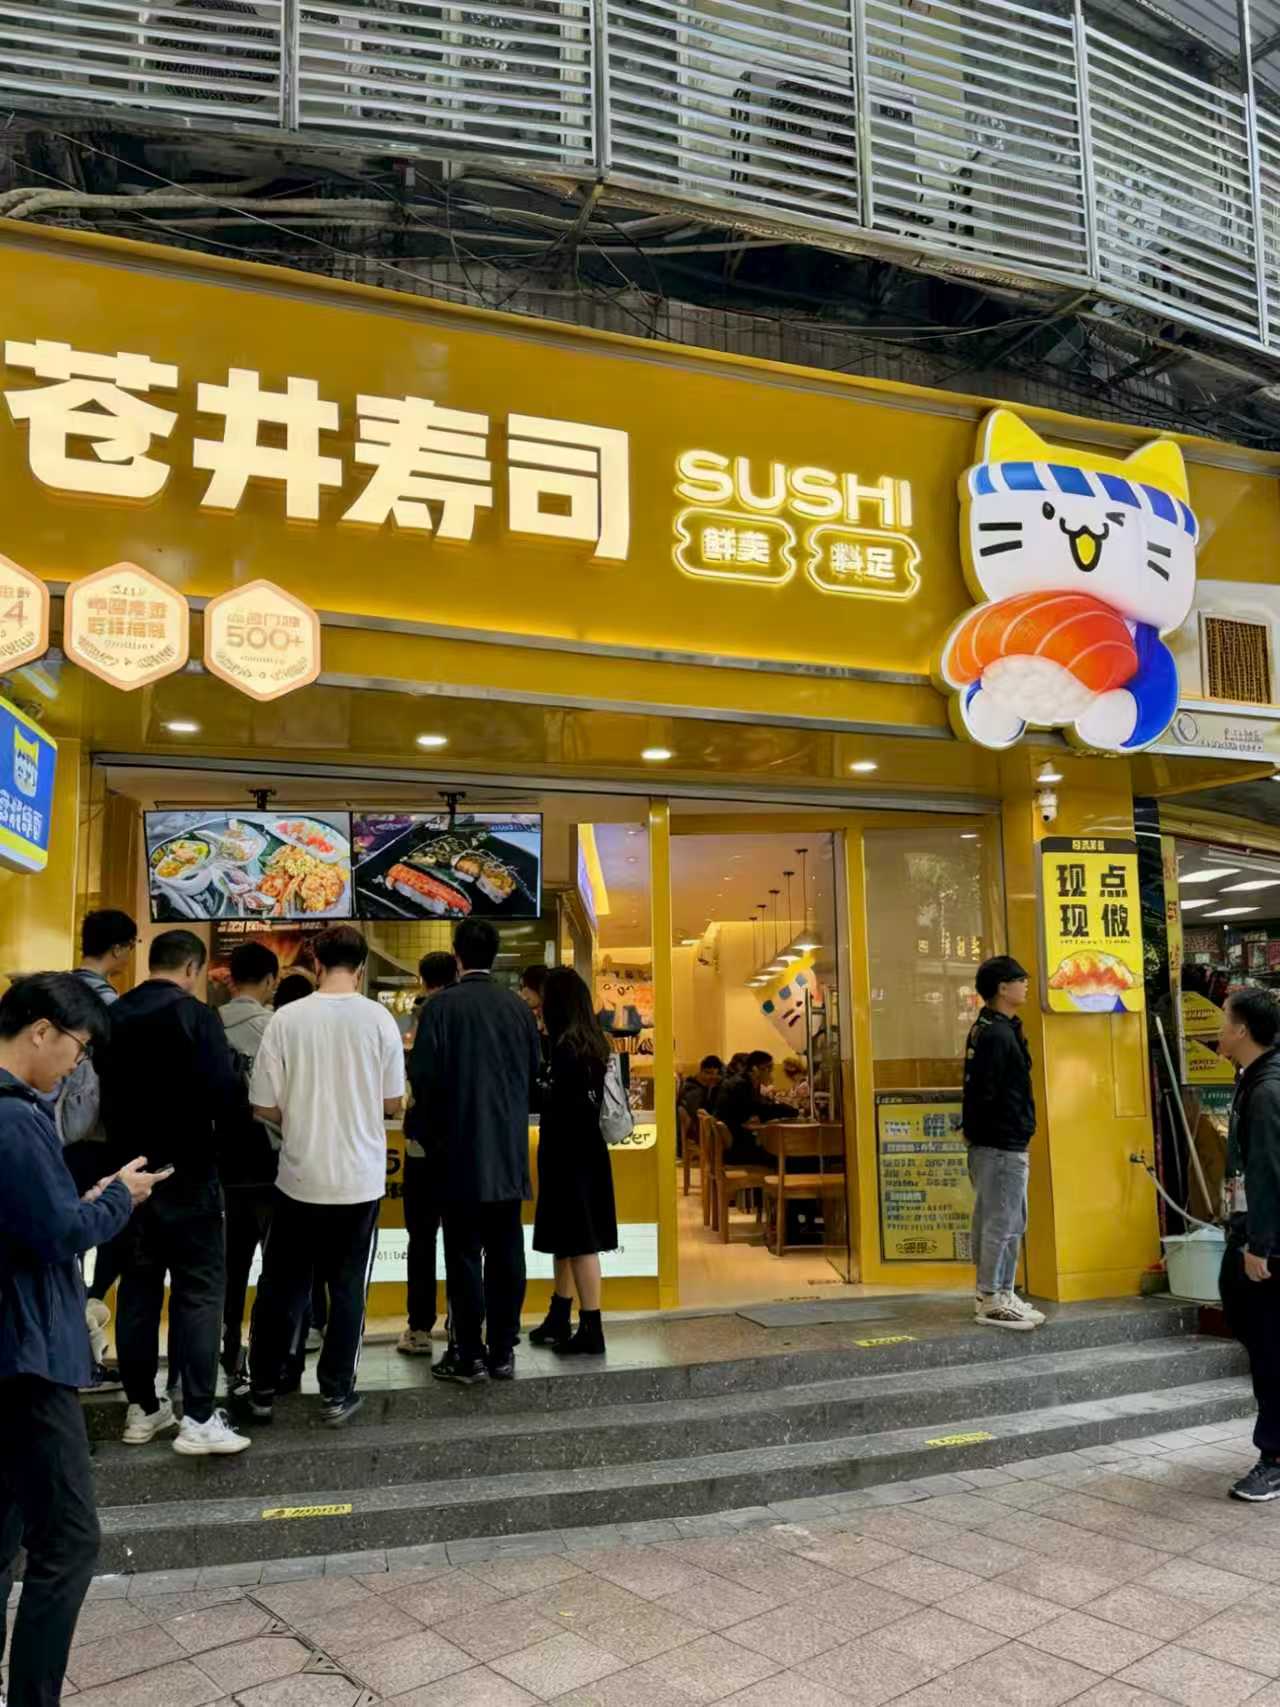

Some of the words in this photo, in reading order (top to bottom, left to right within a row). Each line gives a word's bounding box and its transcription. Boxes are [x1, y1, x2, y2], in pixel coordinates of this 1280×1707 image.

[3, 338, 630, 561] 苍井寿司
[675, 449, 912, 528] SUSHI
[830, 543, 897, 582] 料足
[226, 625, 304, 651] 500+
[1056, 863, 1128, 898] 现点
[1059, 903, 1130, 938] 现做
